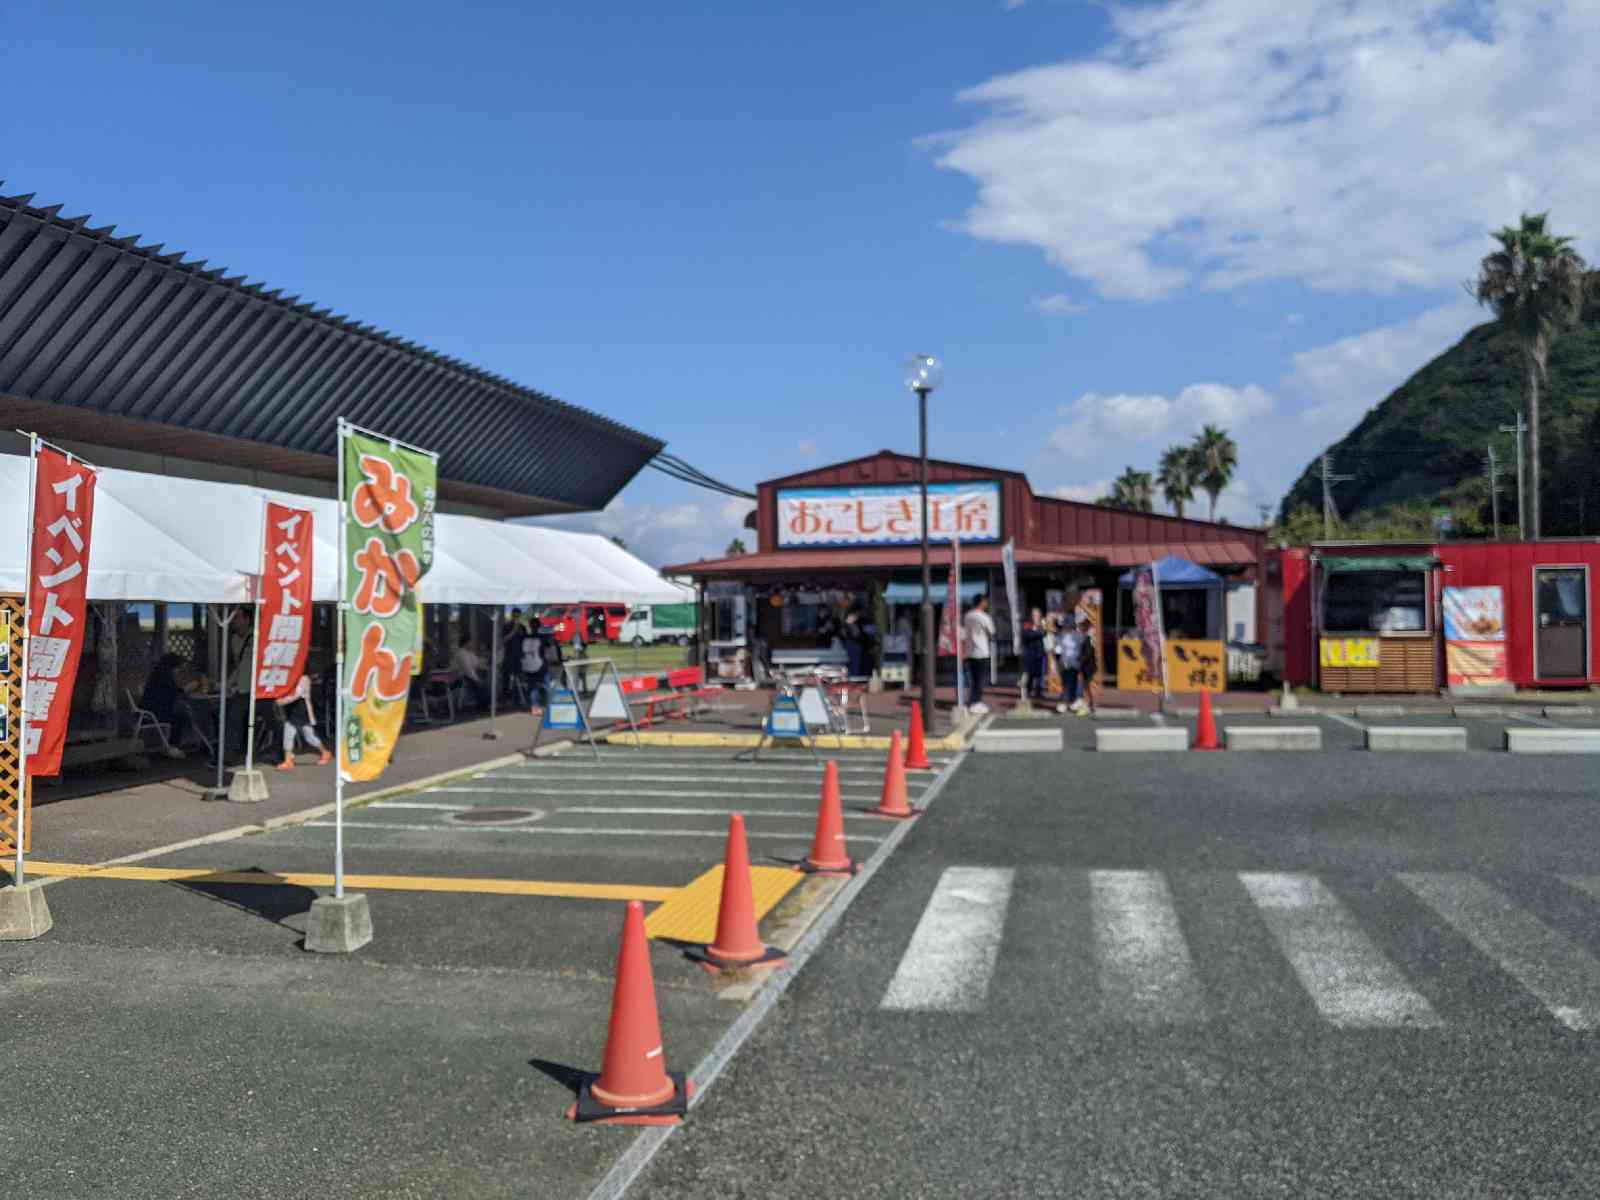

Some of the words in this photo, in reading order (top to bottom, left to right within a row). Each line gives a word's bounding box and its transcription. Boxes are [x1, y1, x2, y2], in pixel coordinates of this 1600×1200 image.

[258, 514, 303, 692] イベント開催中
[352, 454, 420, 700] みかん
